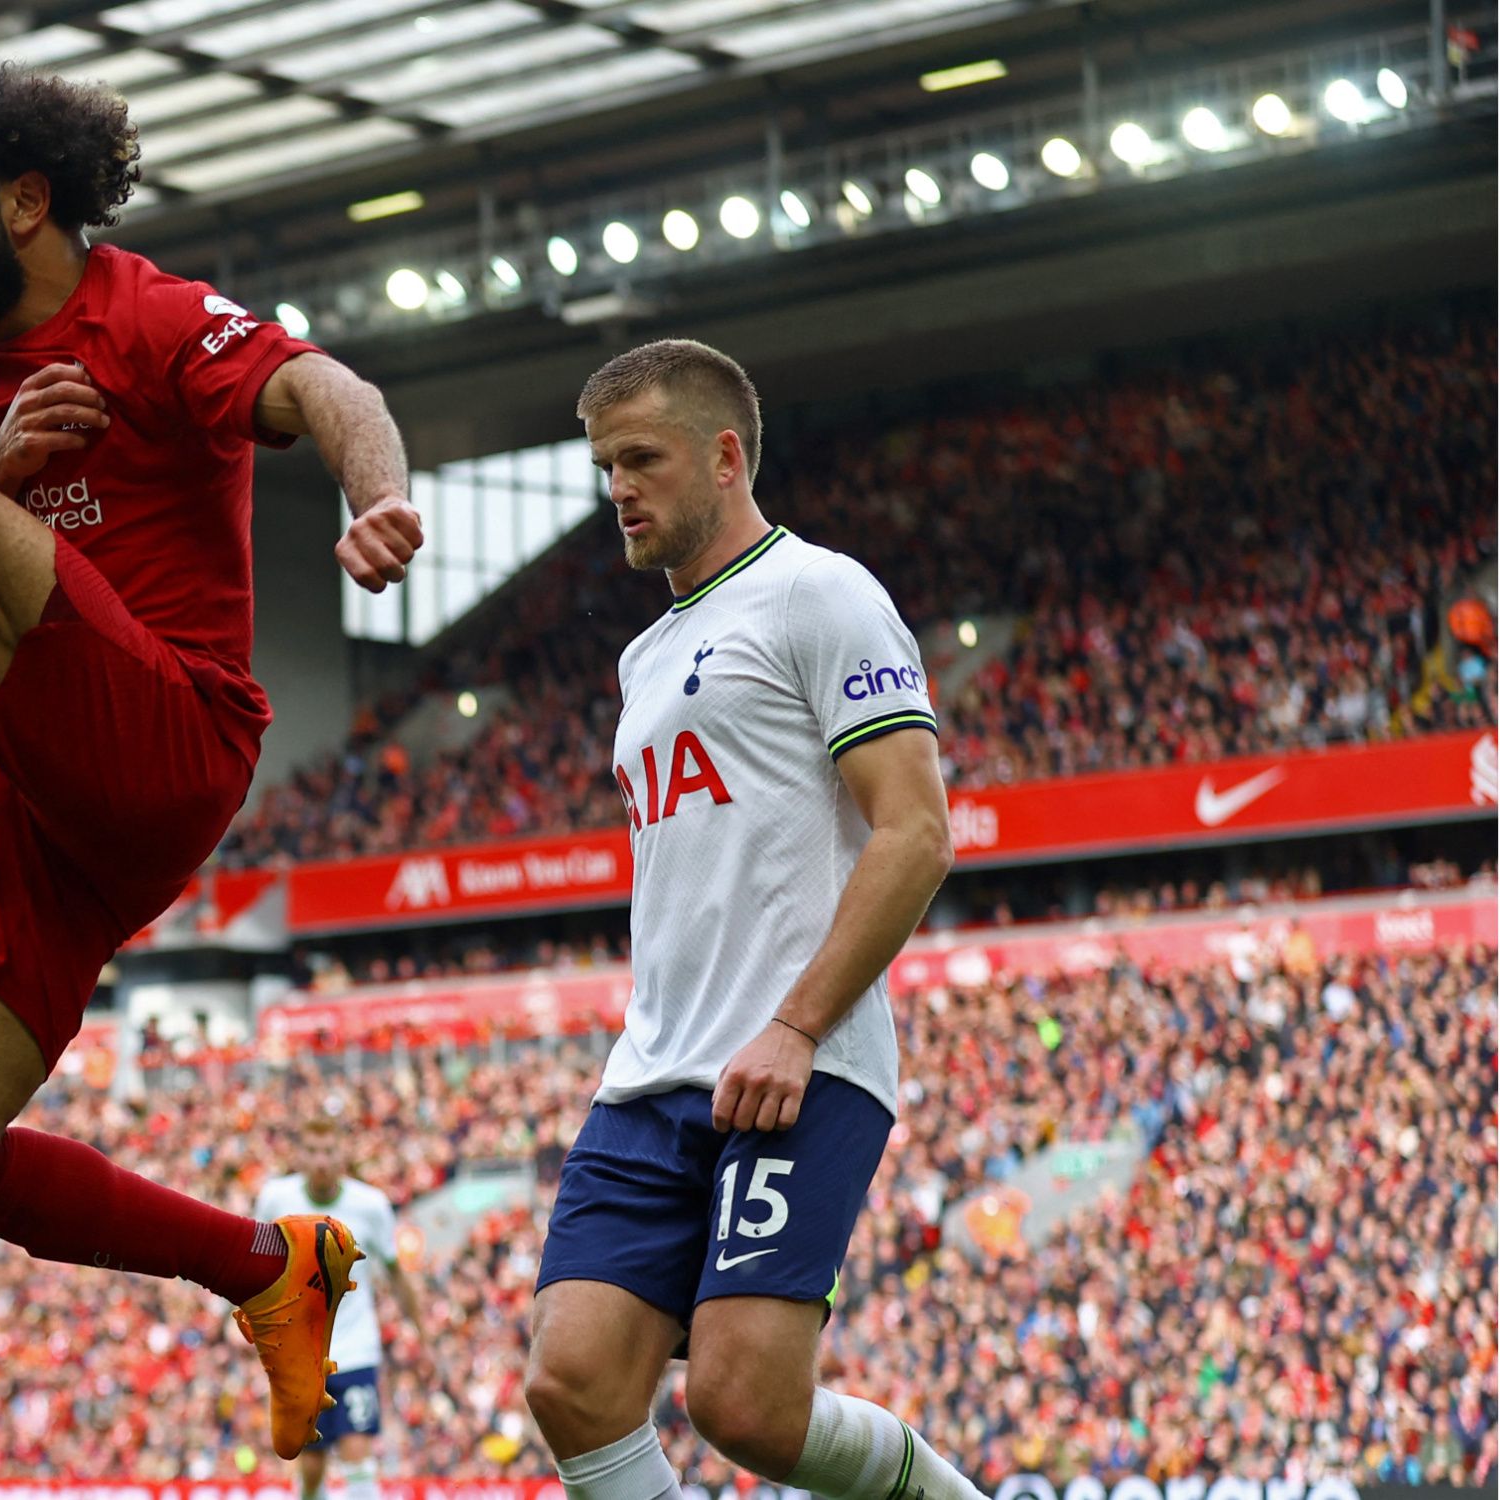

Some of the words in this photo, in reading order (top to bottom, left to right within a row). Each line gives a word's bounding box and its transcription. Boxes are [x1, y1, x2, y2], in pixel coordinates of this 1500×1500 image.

[843, 659, 924, 701] cinch
[615, 730, 733, 833] AIA
[716, 1157, 795, 1241] 15
